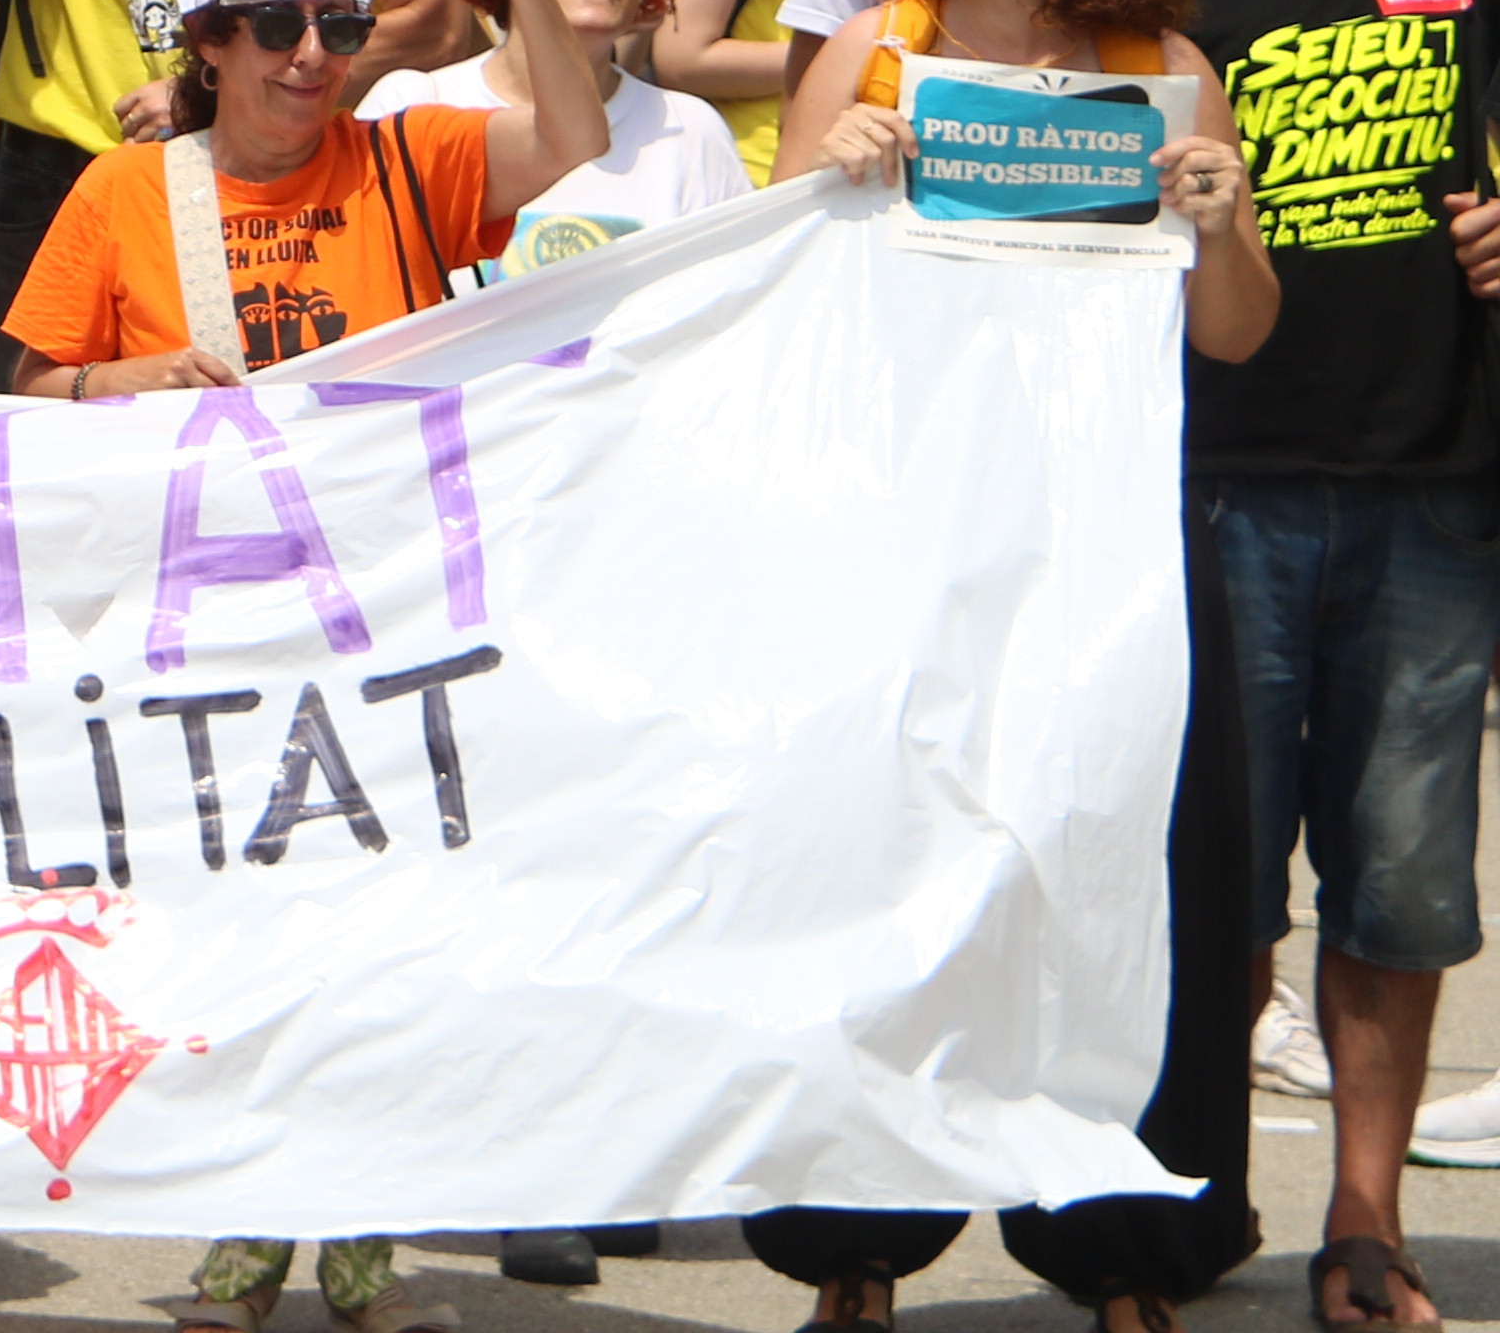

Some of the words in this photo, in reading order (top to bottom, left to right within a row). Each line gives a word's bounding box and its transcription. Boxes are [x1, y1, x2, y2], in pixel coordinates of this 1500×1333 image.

[1233, 64, 1460, 142] NEGOCIEU
[922, 117, 1010, 148] PROU
[1017, 124, 1144, 154] RÀTIOS
[921, 156, 1144, 188] IMPOSSIBLES
[1279, 202, 1329, 227] vaga
[1298, 215, 1362, 246] vostra
